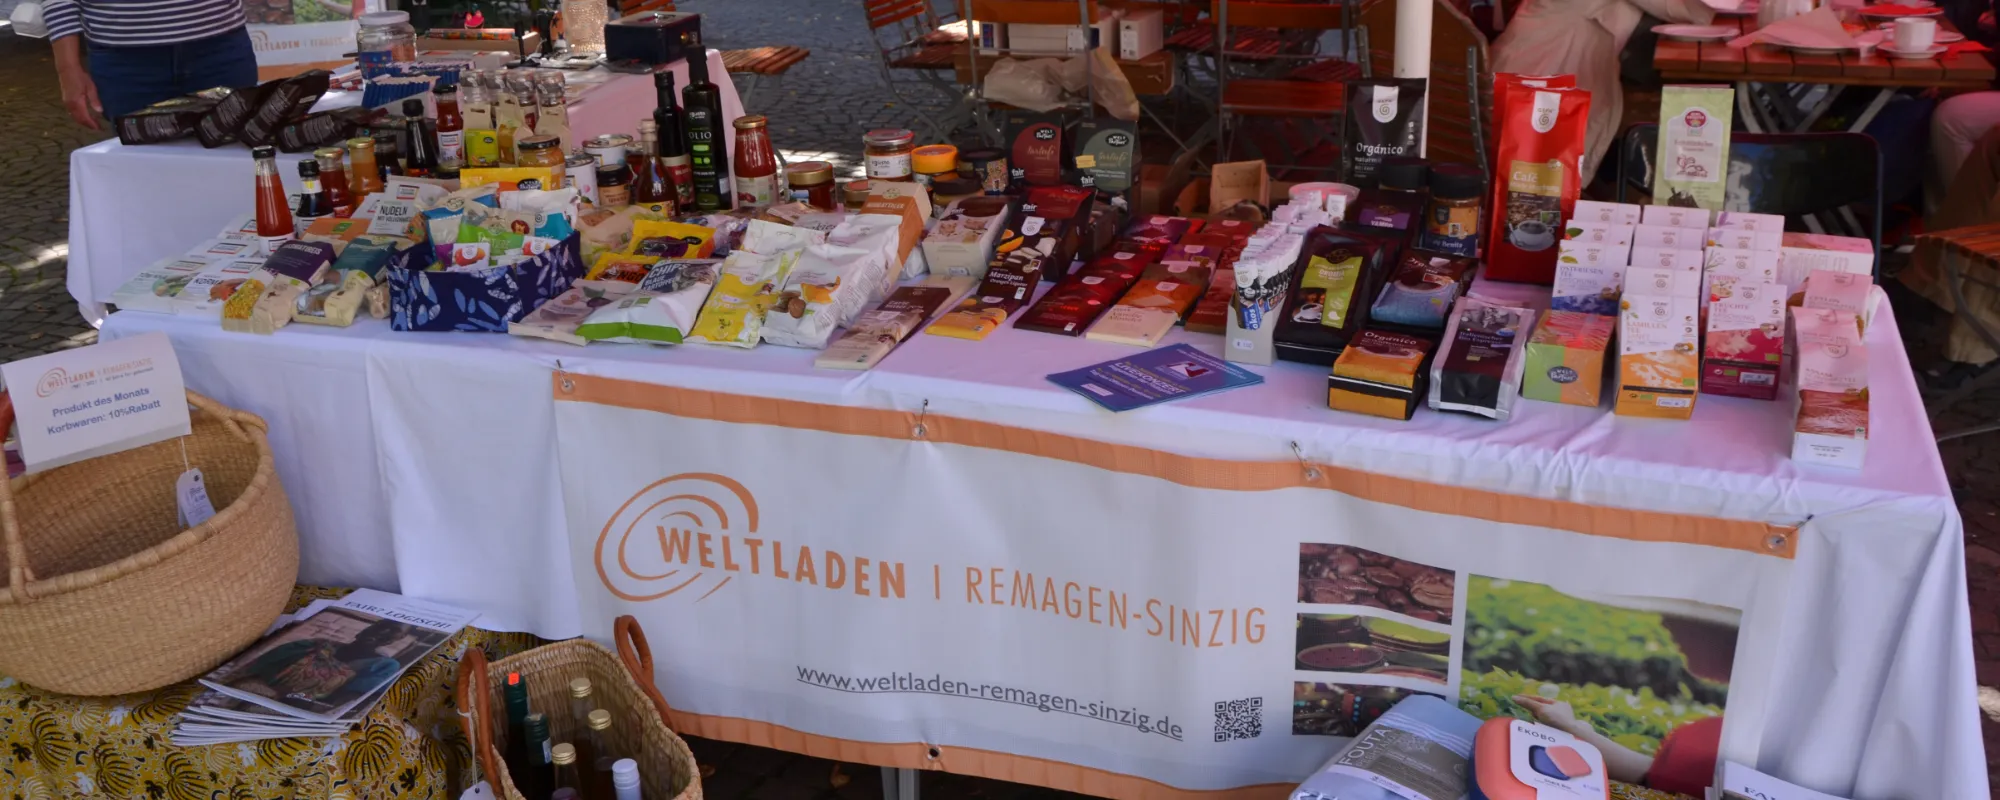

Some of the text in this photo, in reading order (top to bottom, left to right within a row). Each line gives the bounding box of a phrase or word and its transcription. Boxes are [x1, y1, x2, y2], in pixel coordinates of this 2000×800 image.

[689, 131, 712, 140] OLIO
[1356, 142, 1403, 156] Orgánico
[1011, 168, 1024, 177] fair
[1081, 175, 1094, 185] fair
[379, 205, 407, 215] NUDELN
[1022, 203, 1038, 211] fair
[649, 263, 691, 278] CHIPS
[989, 271, 1024, 281] Marzipan
[53, 386, 150, 417] Produkt des Monats
[47, 413, 106, 436] Korbwaren:
[656, 525, 906, 599] WELTLADEN
[965, 566, 1267, 648] REMAGEN-SINZIG
[345, 601, 385, 613] FAIR?
[385, 610, 452, 629] LOGISCH!
[797, 665, 1184, 739] www.weltladen-remagen-sinzig.de
[1517, 726, 1556, 743] EKOBO
[1338, 728, 1392, 765] FOUTA
